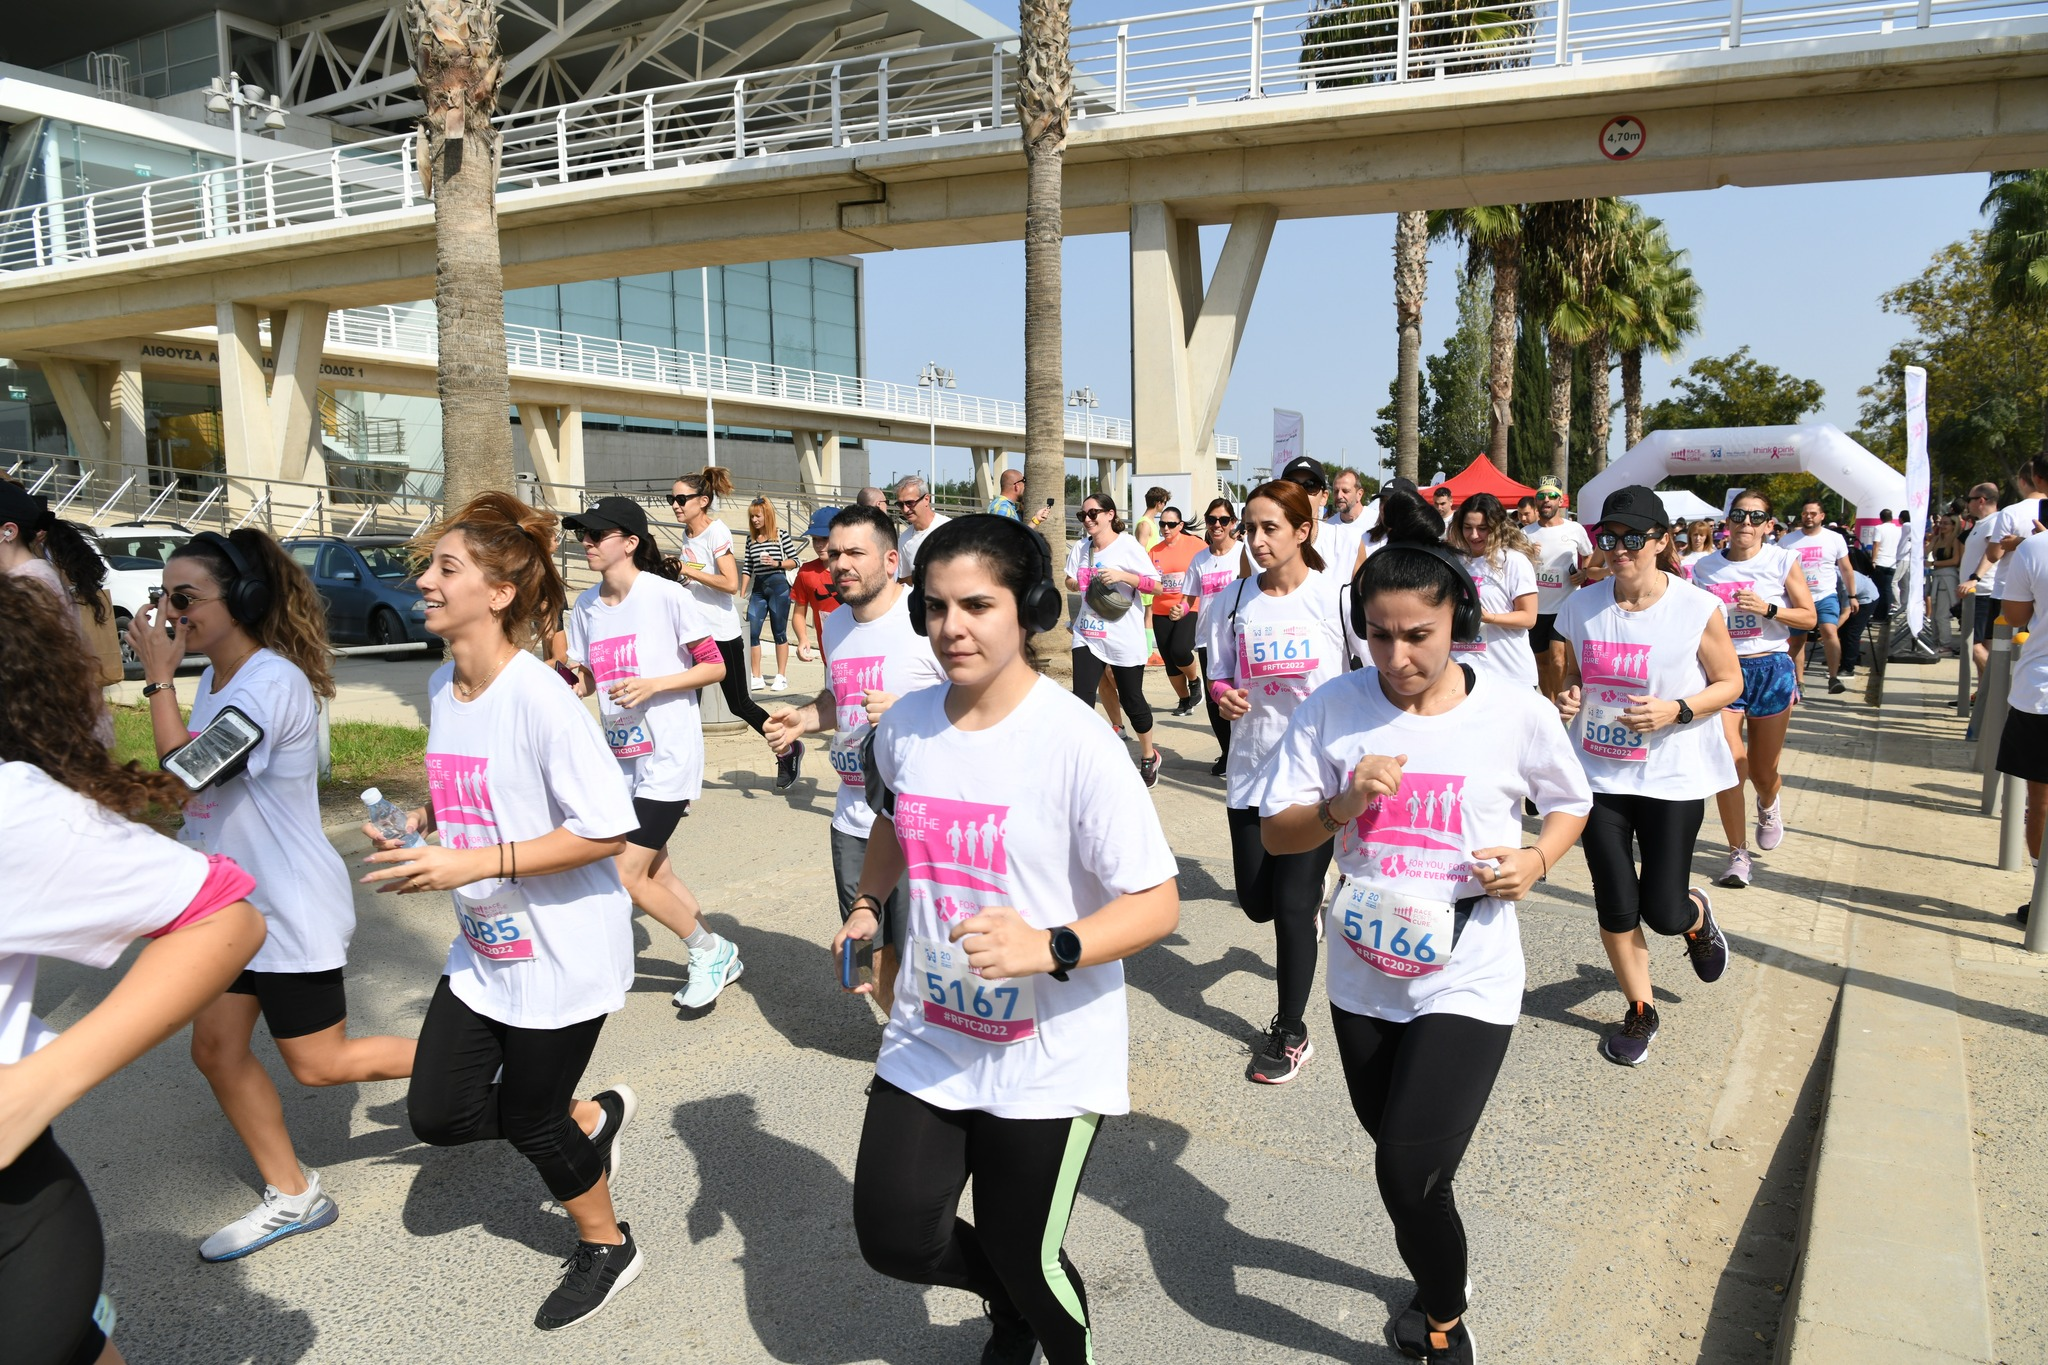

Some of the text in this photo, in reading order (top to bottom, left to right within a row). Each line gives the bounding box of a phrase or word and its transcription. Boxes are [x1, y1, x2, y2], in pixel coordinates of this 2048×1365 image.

[1608, 132, 1640, 143] 4,70m
[141, 345, 203, 362] ΑΙΘΟΥΣΑ
[1163, 579, 1183, 588] 5364
[1536, 572, 1560, 583] 1061
[1728, 614, 1757, 629] 158
[1253, 639, 1310, 662] 5161
[1262, 662, 1305, 671] #RFTC2022
[1586, 721, 1643, 747] 5083
[1590, 744, 1632, 756] #RFTC2022
[439, 770, 451, 781] THE
[898, 800, 928, 815] RACE
[896, 813, 940, 831] FOR THE
[1408, 859, 1466, 872] FOR YOU, FOR
[1404, 869, 1422, 878] FOR
[1367, 892, 1379, 901] 20
[959, 900, 976, 909] FOR
[1413, 908, 1432, 916] RACE
[1344, 909, 1436, 963] 5166
[940, 951, 952, 961] 20
[1356, 947, 1421, 974] #RFTC2022
[926, 972, 1019, 1020] 5167
[943, 1011, 1008, 1036] #RFTC2022
